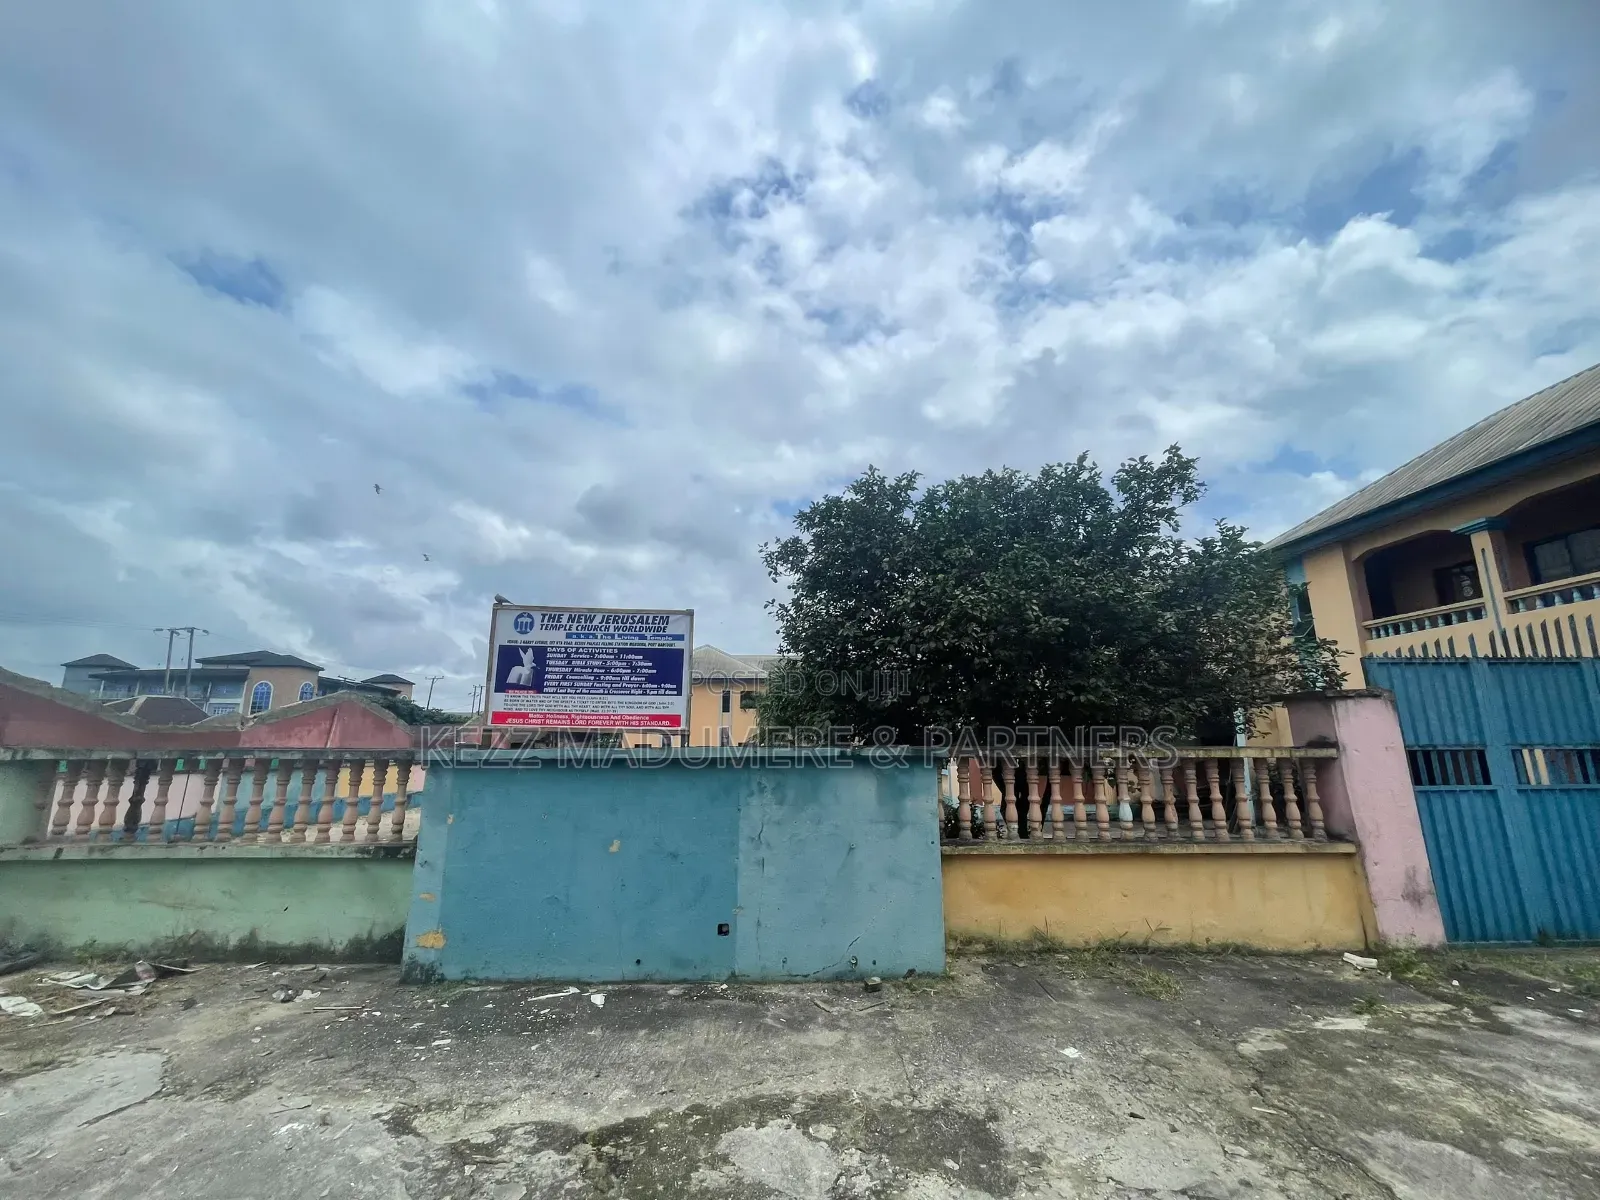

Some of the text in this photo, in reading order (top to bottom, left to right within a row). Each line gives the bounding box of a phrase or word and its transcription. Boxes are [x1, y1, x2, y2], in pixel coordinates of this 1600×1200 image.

[540, 613, 670, 626] THE NEW JERUSALEM
[540, 623, 668, 634] TEMPLE CHURCH WORLDWIDE
[614, 633, 640, 641] Living
[645, 634, 673, 642] Temple
